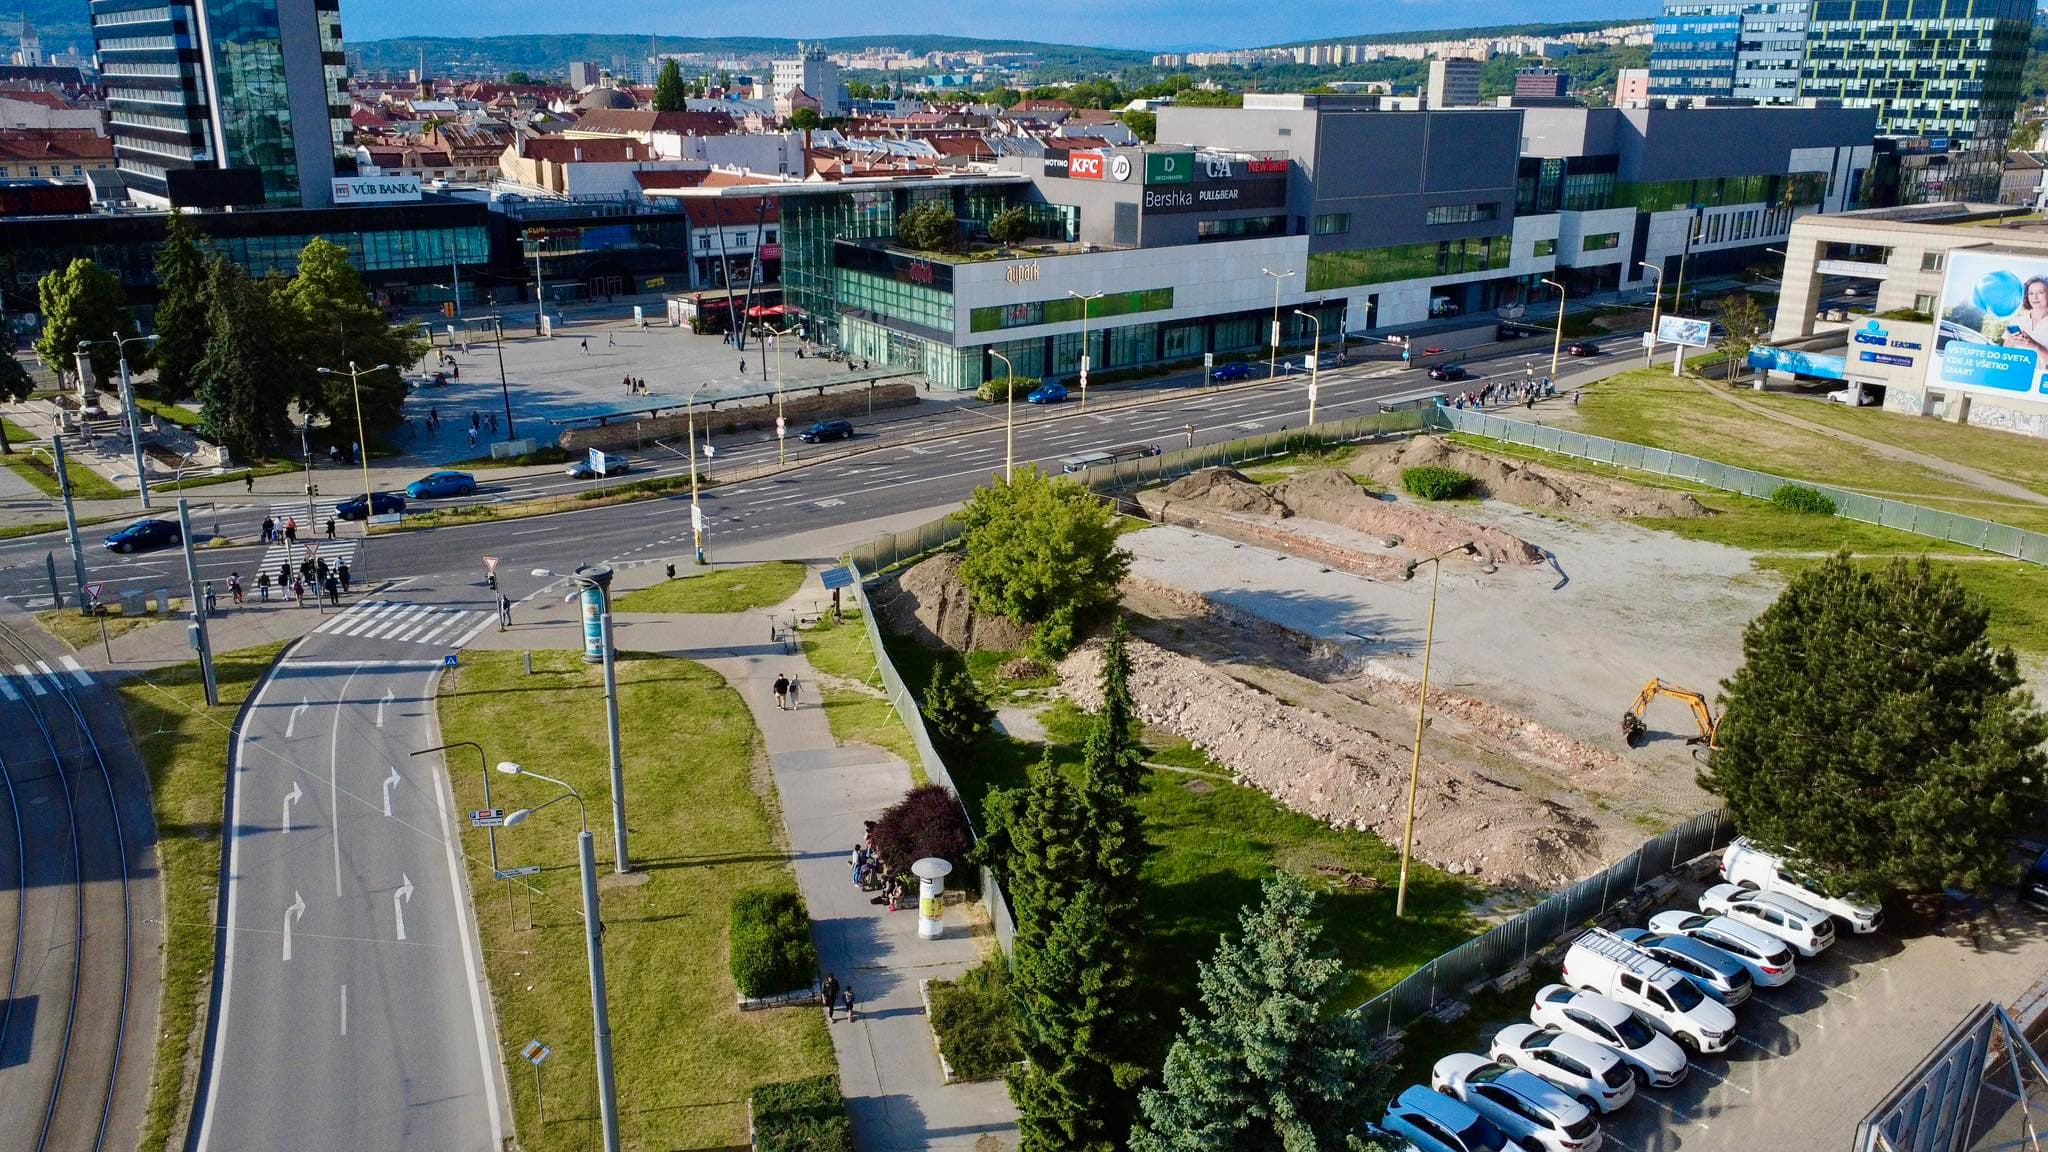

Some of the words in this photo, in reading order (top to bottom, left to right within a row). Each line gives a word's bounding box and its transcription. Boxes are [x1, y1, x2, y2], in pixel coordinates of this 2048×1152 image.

[1045, 159, 1068, 168] NOTINO
[1071, 158, 1099, 174] KFC
[1114, 162, 1128, 174] JD
[1206, 157, 1232, 178] C&A
[352, 182, 377, 195] VÚB
[379, 183, 419, 194] BANKA
[1199, 189, 1239, 201] PULL&BEAR
[1146, 190, 1193, 207] Bershka
[1007, 260, 1040, 285] aupark
[1890, 340, 1922, 351] LEASING
[1987, 351, 2001, 359] DO
[2002, 352, 2032, 364] SVETA,
[1965, 359, 1974, 367] JE
[1975, 358, 2009, 371] VŠETKO
